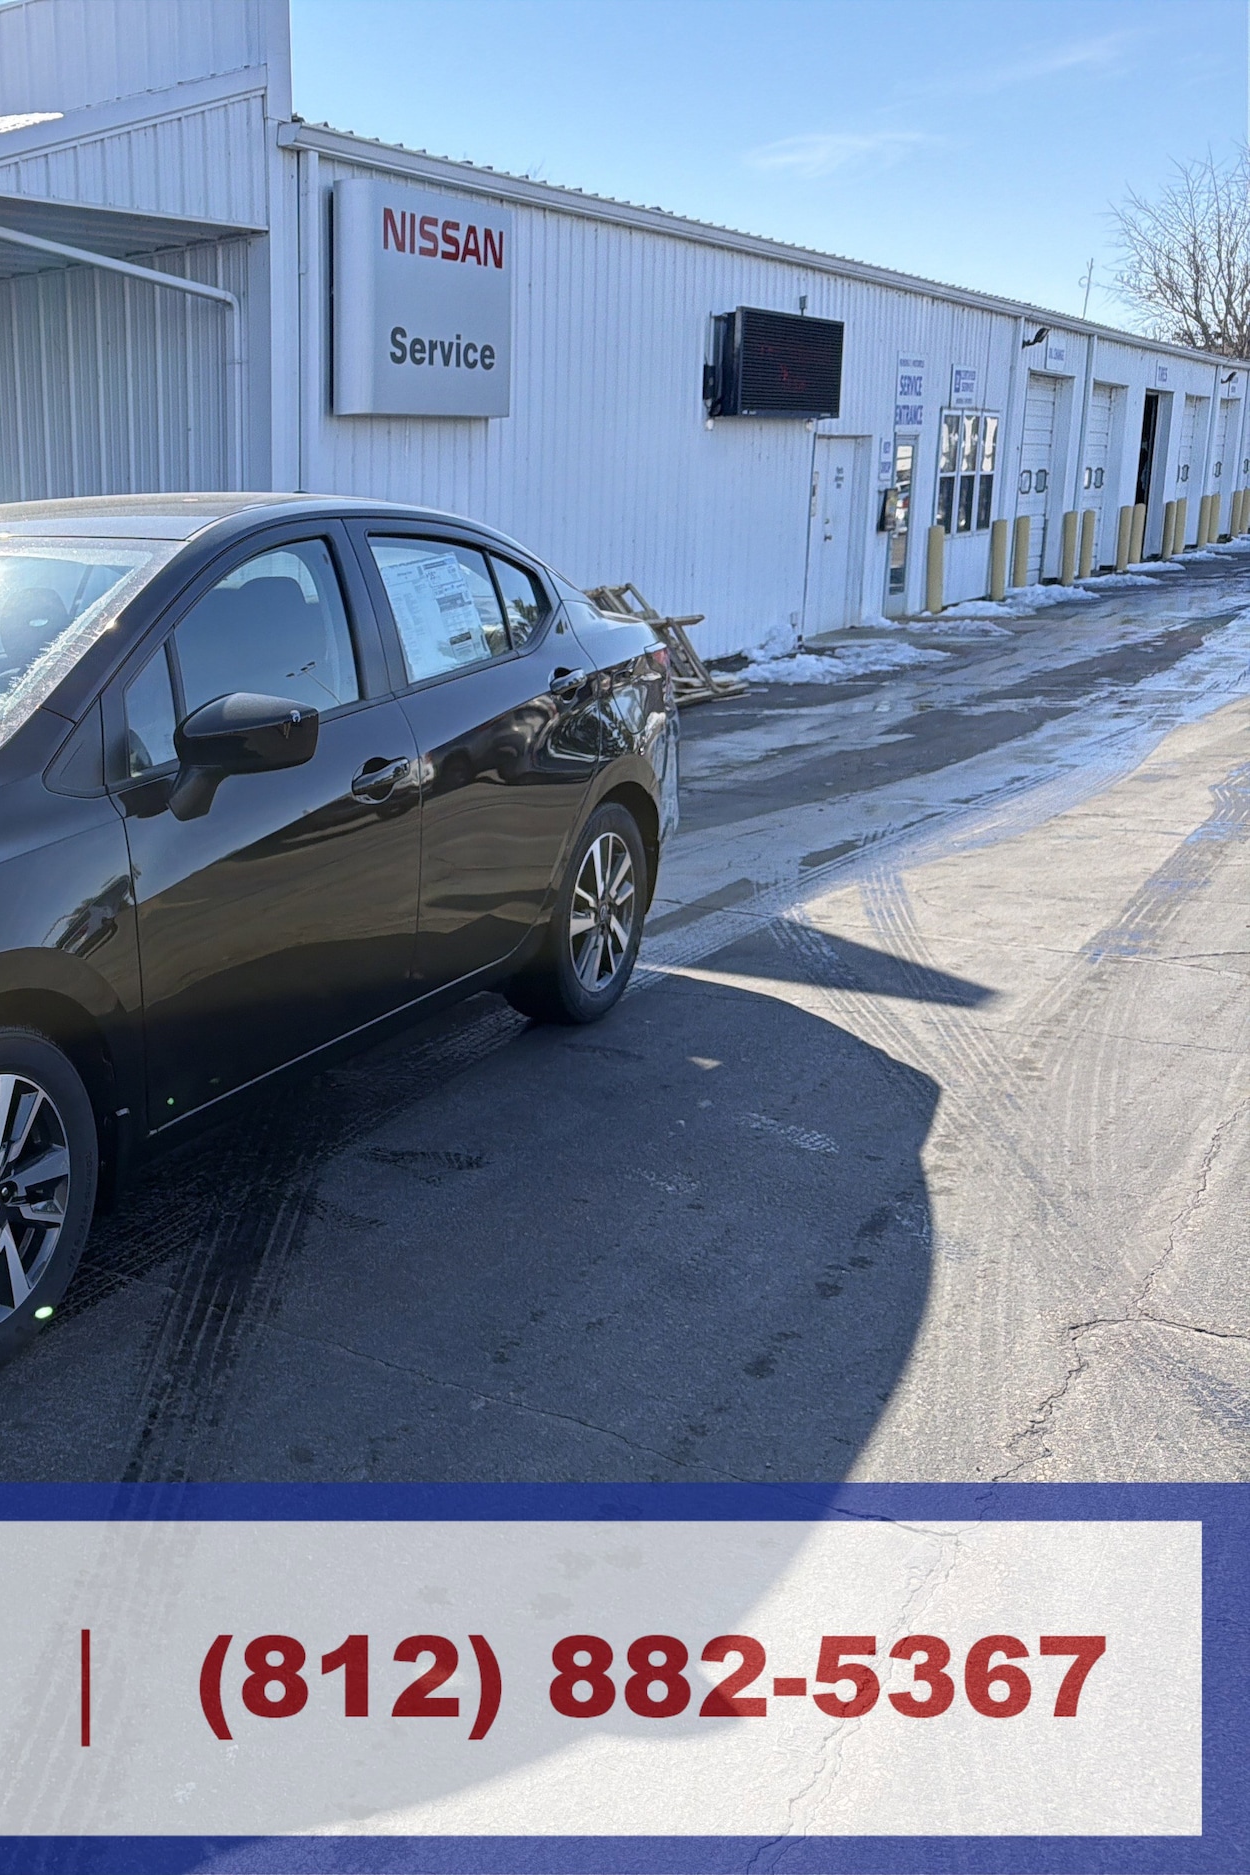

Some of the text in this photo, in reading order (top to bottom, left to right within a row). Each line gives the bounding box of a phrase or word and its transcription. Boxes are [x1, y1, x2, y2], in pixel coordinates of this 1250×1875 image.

[383, 207, 503, 269] NISSAN
[389, 326, 495, 371] Service
[899, 374, 923, 396] SERVICE
[895, 405, 923, 425] ENTRANCE
